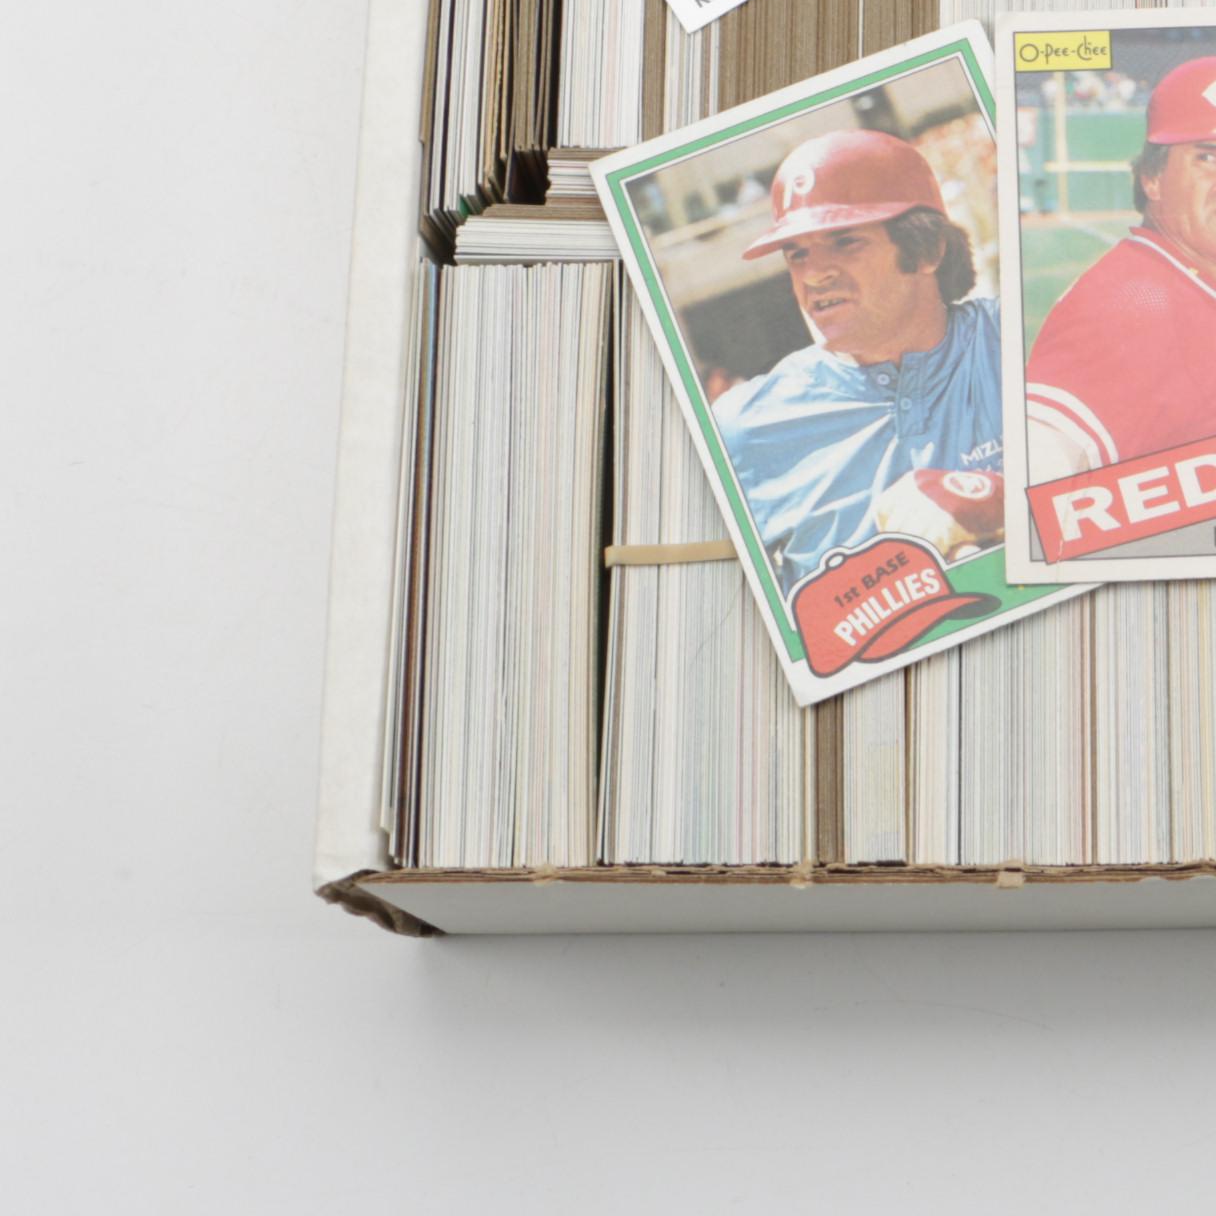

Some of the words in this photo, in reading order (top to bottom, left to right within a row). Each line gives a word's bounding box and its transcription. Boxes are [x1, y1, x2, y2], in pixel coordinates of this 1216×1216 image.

[833, 567, 941, 647] PHILLIES
[834, 586, 862, 608] 1st
[861, 551, 909, 590] BASE
